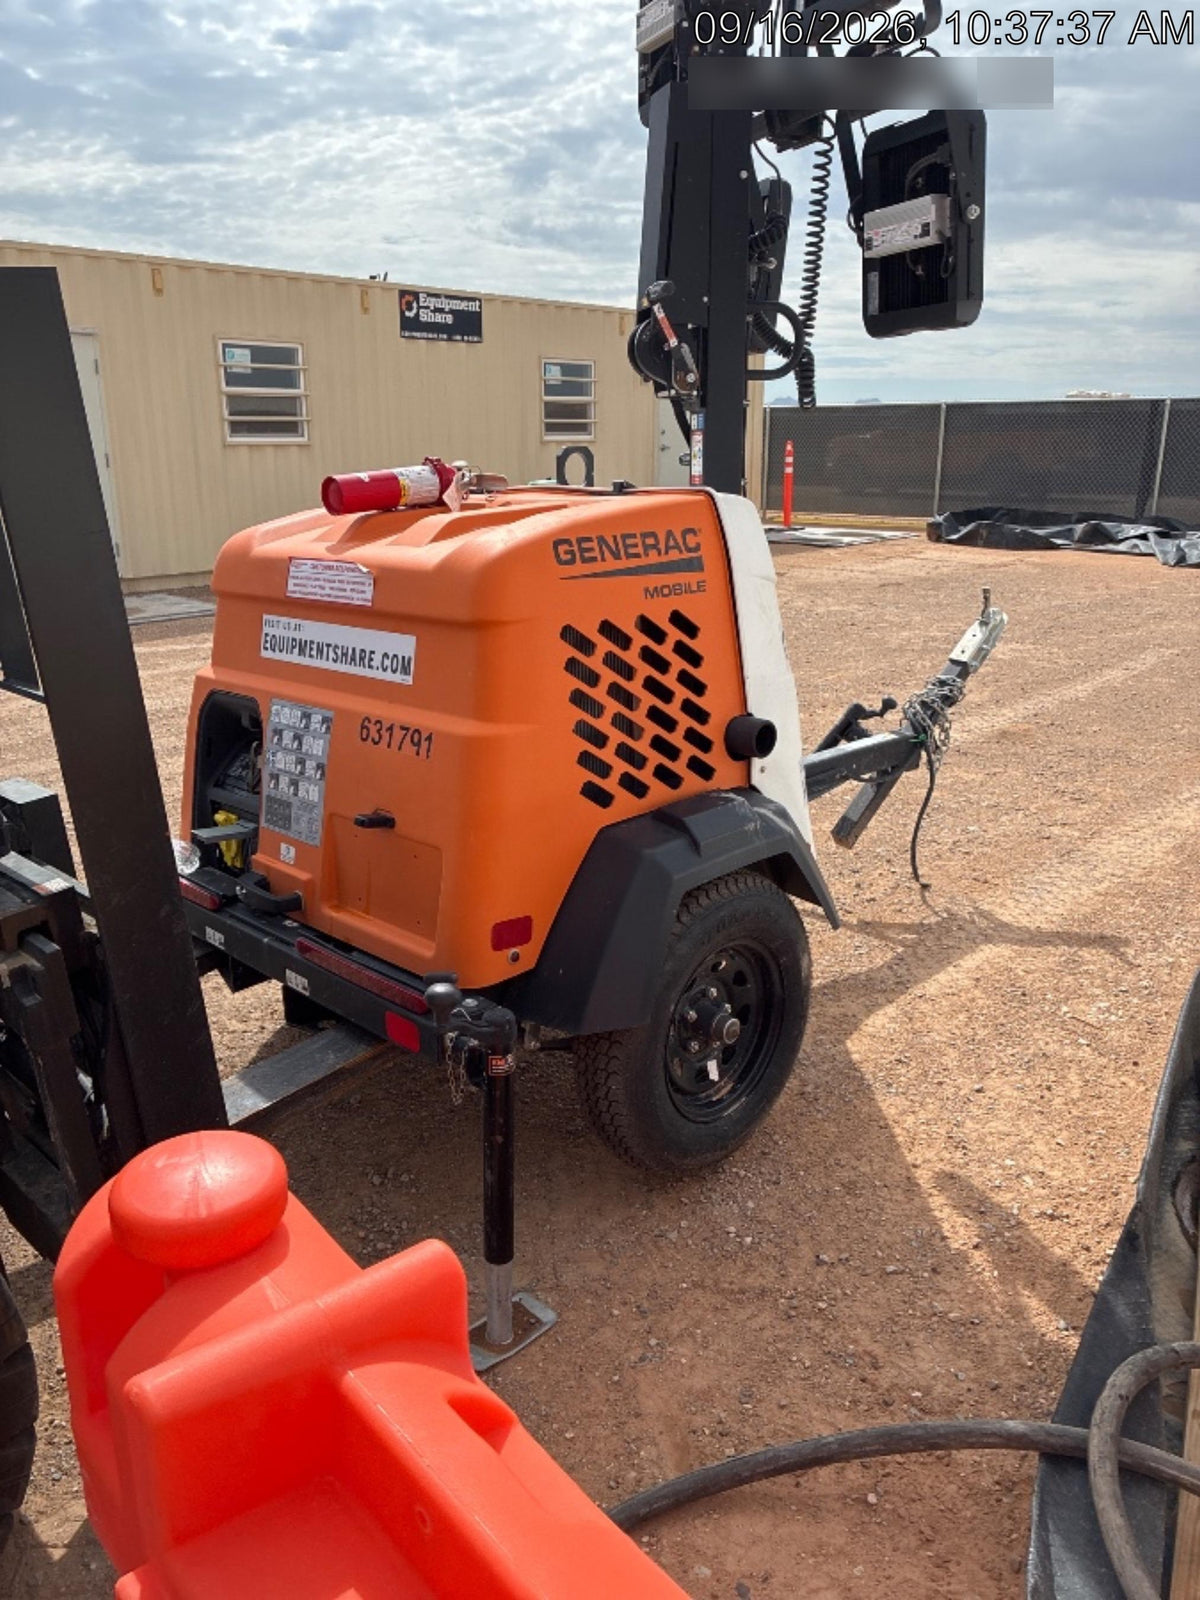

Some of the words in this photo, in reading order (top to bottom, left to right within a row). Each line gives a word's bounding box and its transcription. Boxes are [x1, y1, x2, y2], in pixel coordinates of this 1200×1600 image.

[419, 293, 480, 312] Equipment
[419, 309, 453, 324] Share
[552, 528, 701, 566] GENERAC
[644, 580, 706, 600] MOBILE
[263, 632, 413, 676] EQUIPMENTSHARE.COM
[360, 716, 433, 759] 631791
